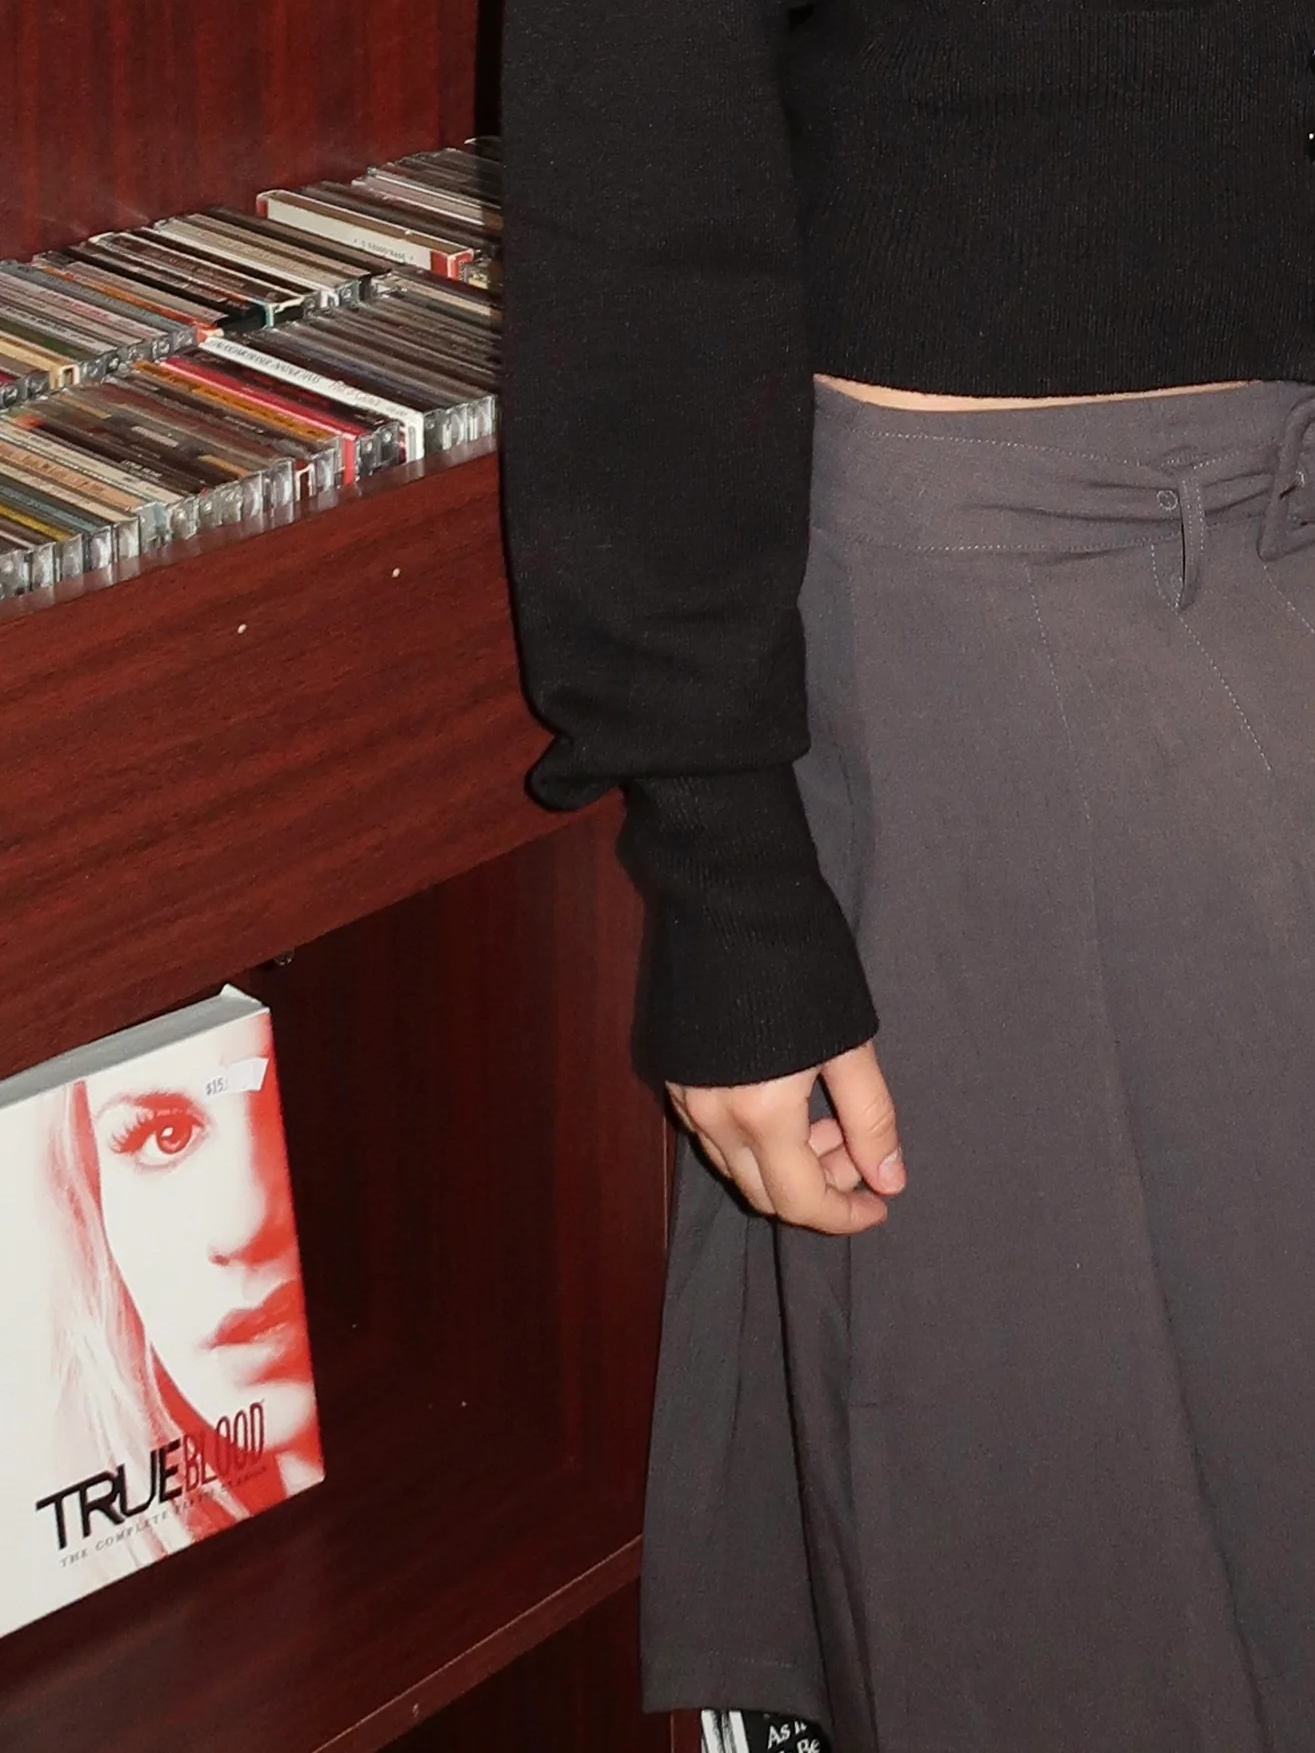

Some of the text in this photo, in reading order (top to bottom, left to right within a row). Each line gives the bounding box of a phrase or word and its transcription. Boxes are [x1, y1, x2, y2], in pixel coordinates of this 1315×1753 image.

[35, 1401, 267, 1550] TRUE BLOOD
[59, 1547, 89, 1568] THE
[93, 1506, 172, 1553] COMPLETE
